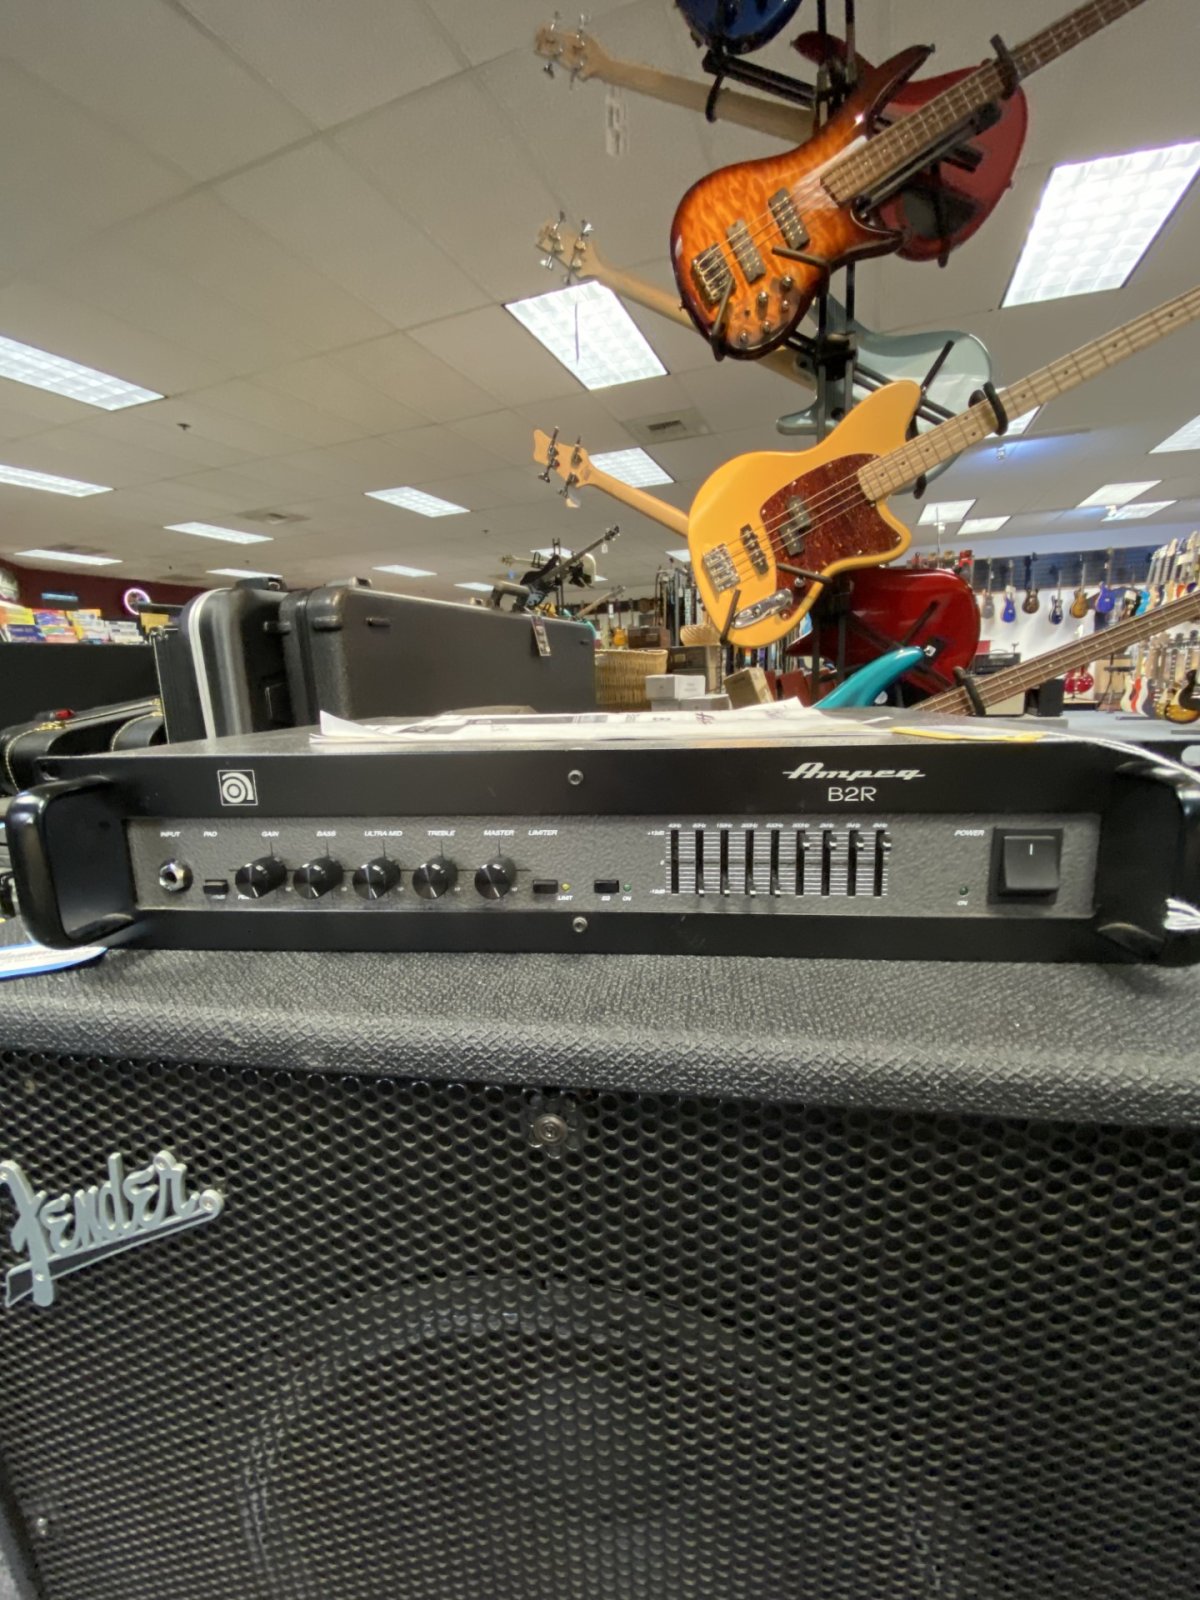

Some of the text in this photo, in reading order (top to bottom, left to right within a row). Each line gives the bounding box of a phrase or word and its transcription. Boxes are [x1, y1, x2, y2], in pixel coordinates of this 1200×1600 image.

[782, 762, 926, 781] Ampeg
[827, 786, 877, 802] B2R
[954, 829, 985, 837] POWER
[0, 1150, 224, 1307] Fender
